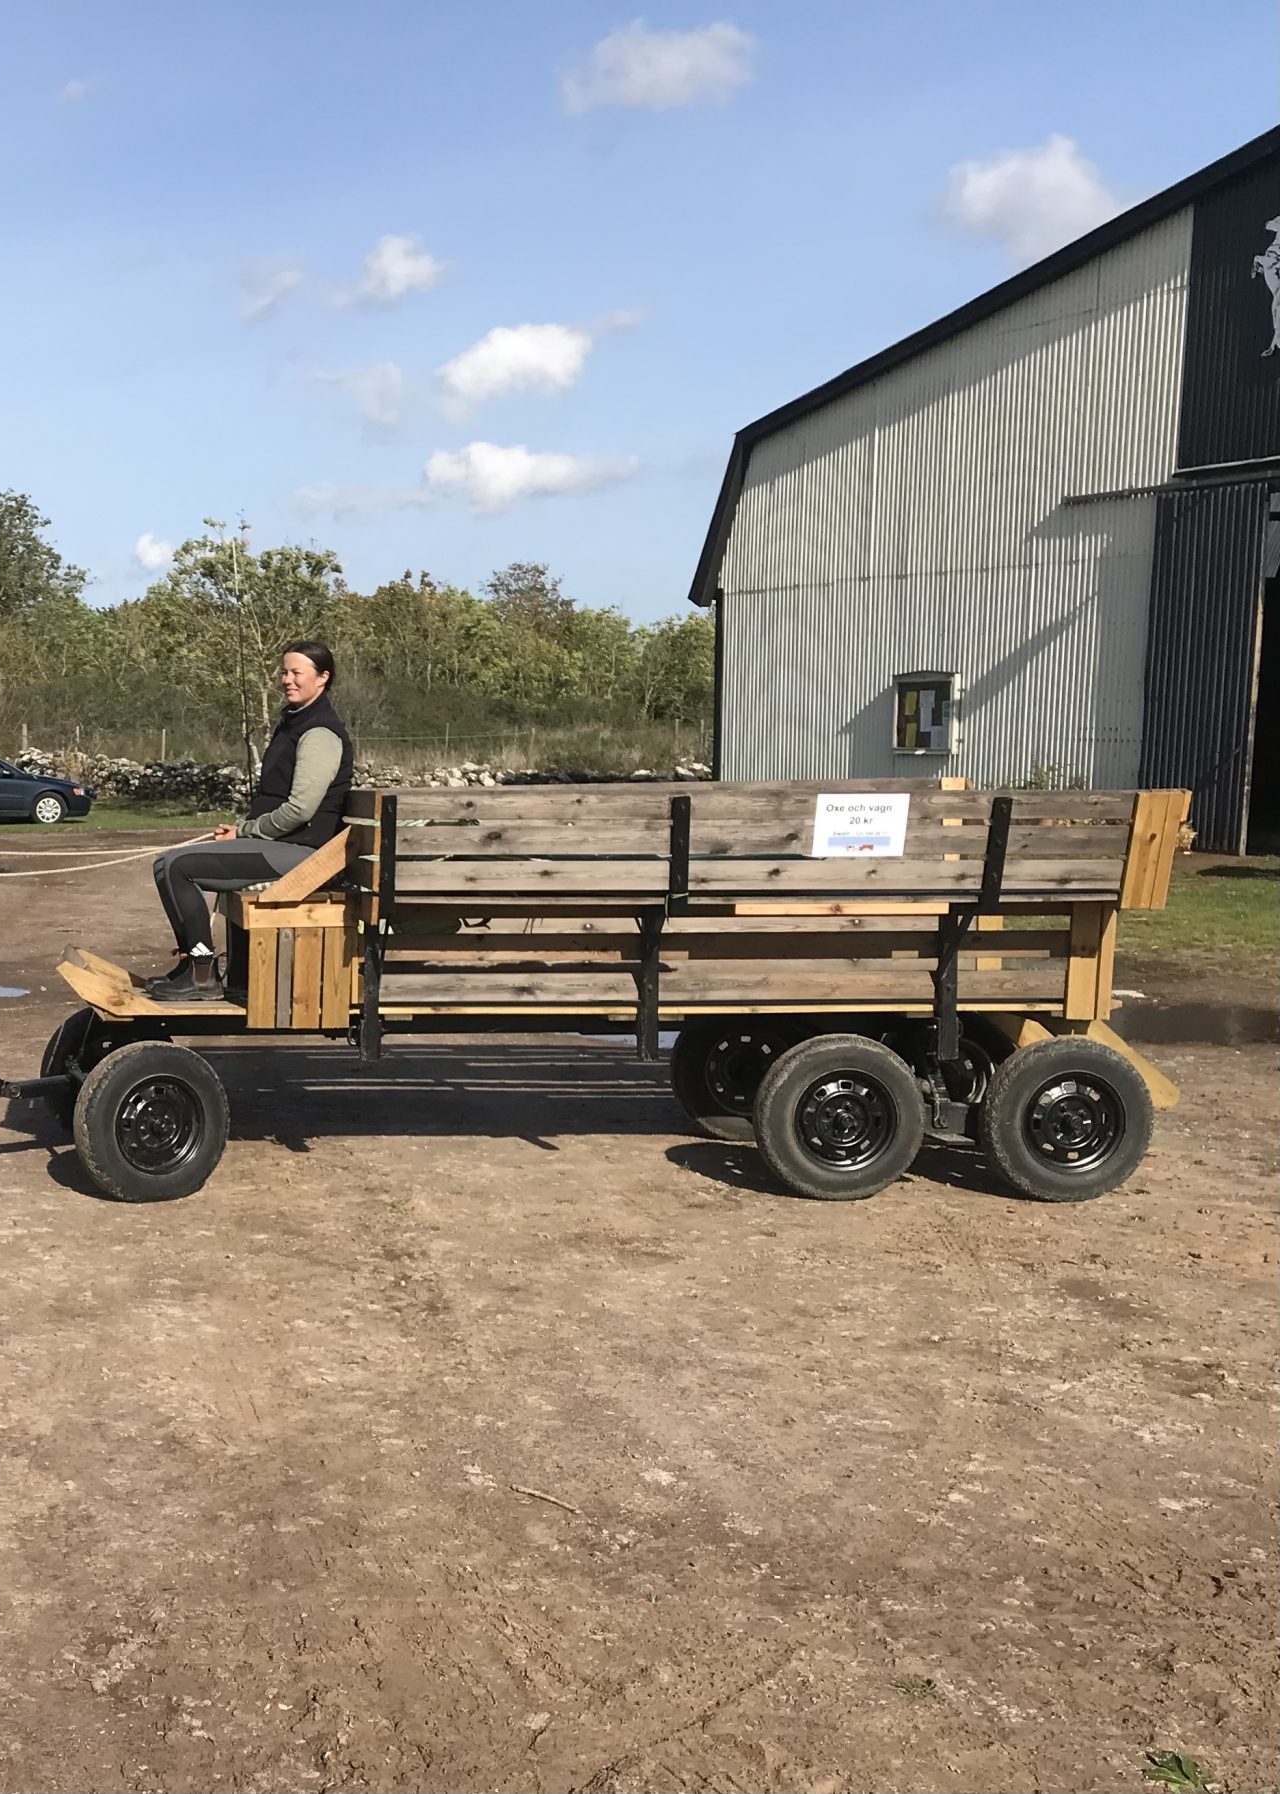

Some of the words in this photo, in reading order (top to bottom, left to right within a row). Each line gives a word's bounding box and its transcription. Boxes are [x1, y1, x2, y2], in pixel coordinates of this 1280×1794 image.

[826, 804, 845, 812] Oxe
[848, 804, 866, 812] och
[869, 805, 892, 813] vagn
[849, 816, 861, 824] 20
[863, 816, 873, 824] kr
